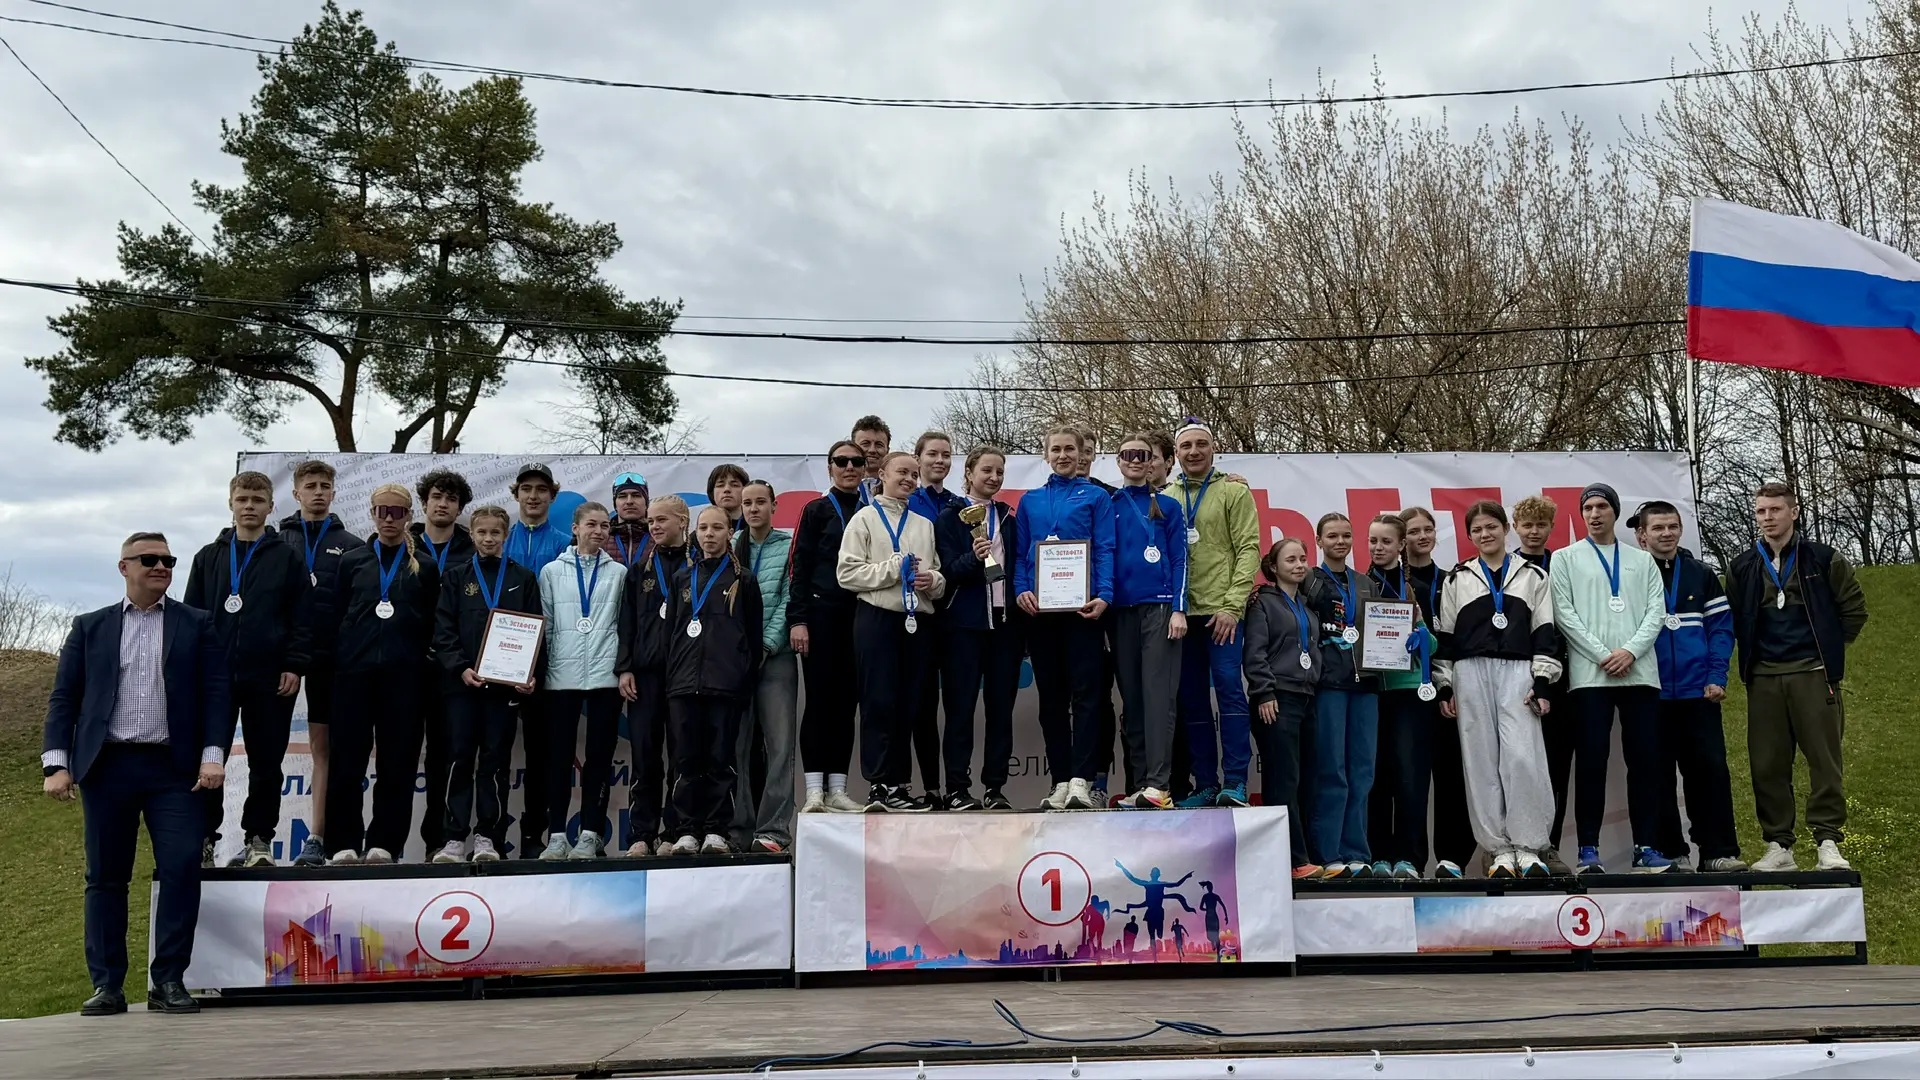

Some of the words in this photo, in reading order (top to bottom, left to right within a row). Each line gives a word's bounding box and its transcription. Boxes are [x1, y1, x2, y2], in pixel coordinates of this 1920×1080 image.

[1041, 868, 1062, 912] 1
[440, 906, 471, 951] 2
[1571, 907, 1591, 937] 3
